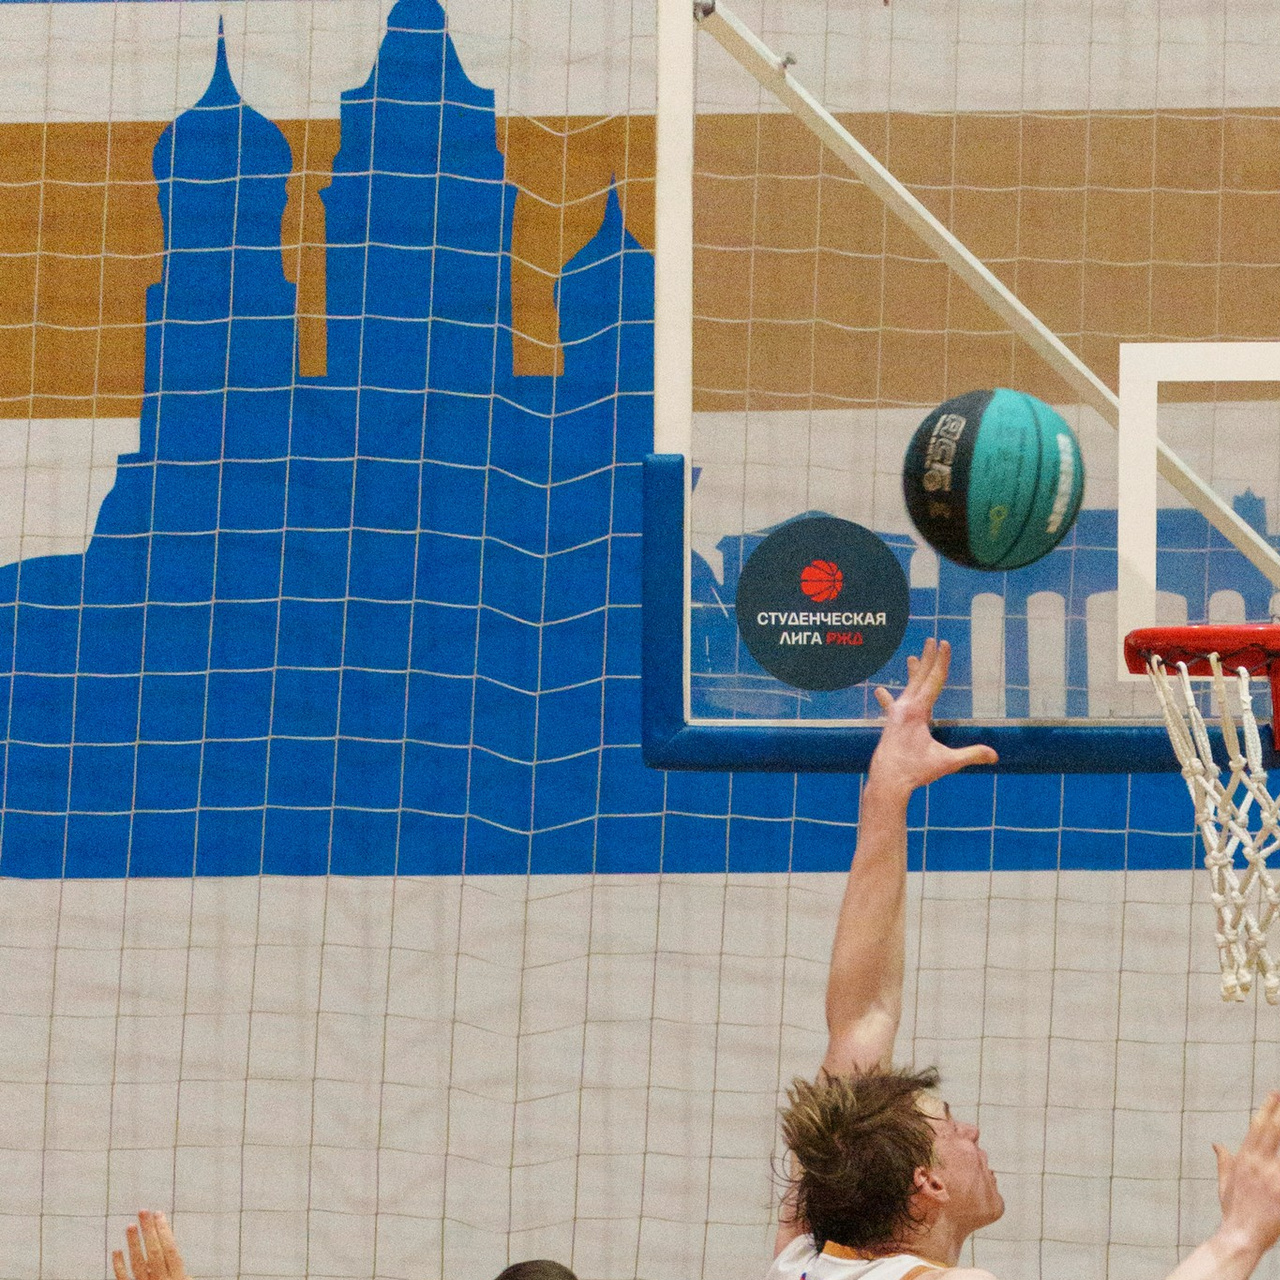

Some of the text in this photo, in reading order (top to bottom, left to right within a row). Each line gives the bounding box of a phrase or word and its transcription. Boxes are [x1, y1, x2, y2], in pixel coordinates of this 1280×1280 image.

[757, 611, 887, 626] СТУДЕНЧЕСКАЯ
[780, 631, 864, 646] ЛИГА РЖД
